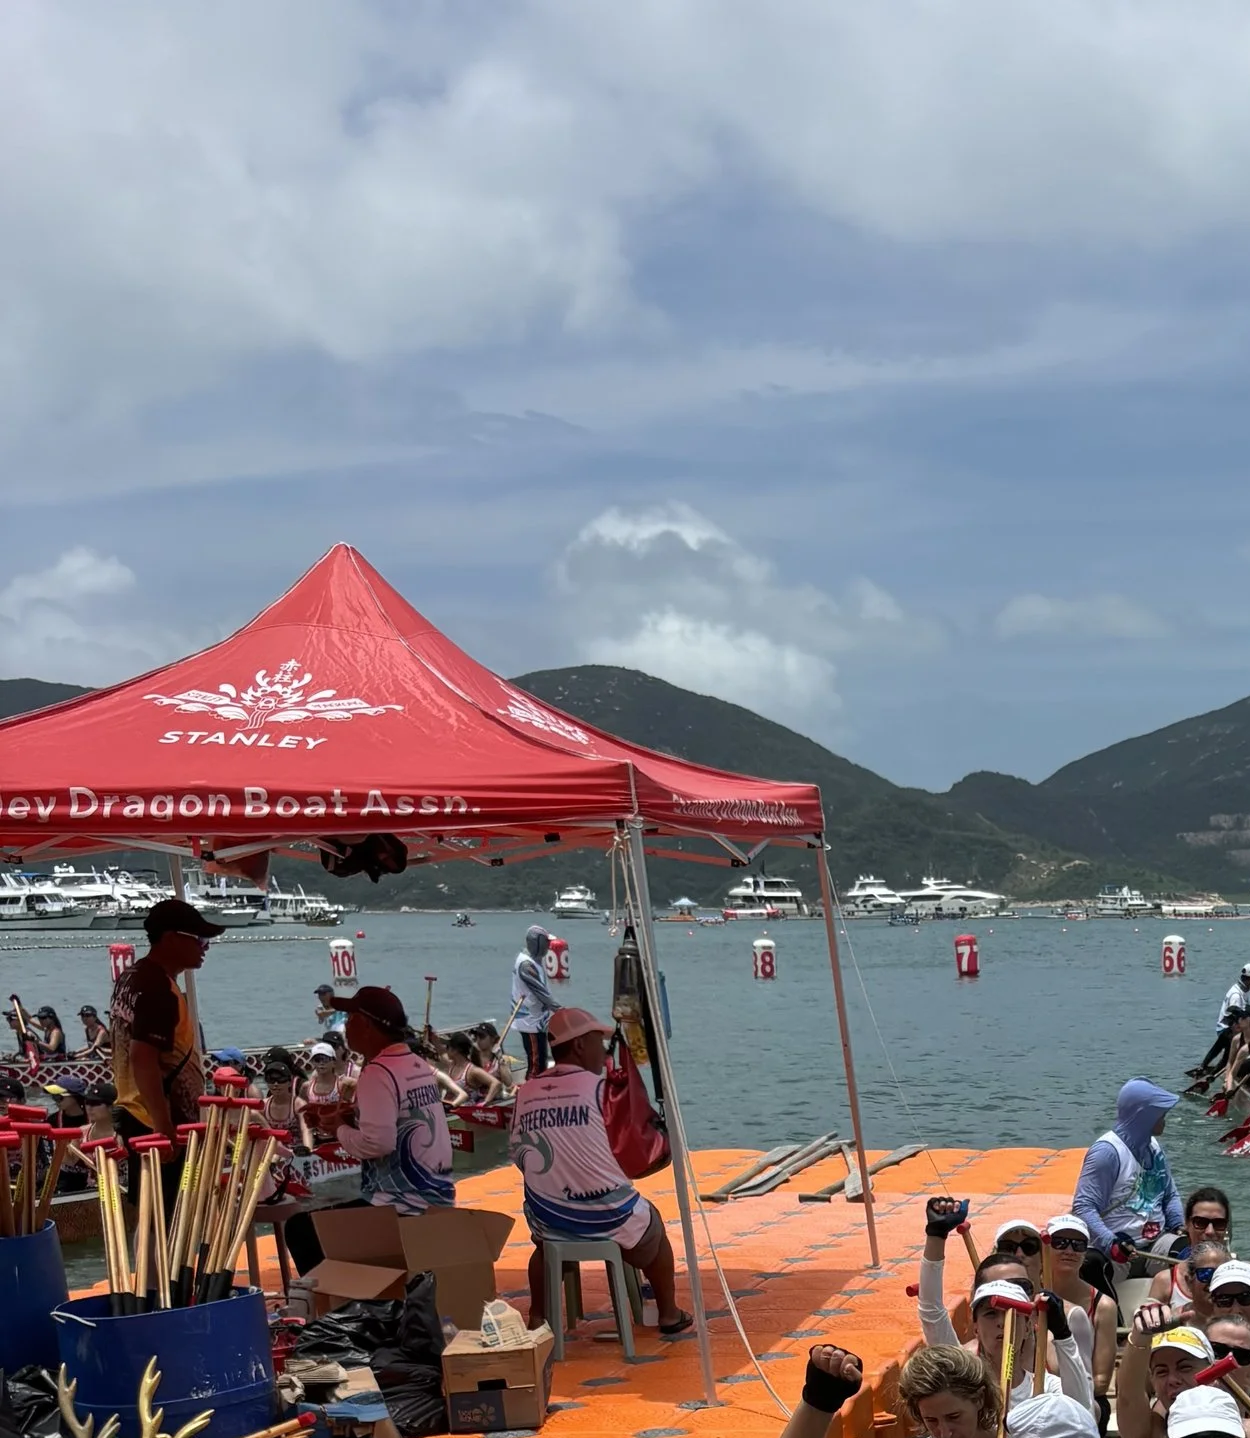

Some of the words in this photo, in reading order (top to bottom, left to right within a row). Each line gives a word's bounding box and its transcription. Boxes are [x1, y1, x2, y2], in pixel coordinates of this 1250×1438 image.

[158, 731, 328, 750] STANLEY
[0, 794, 57, 823] ey
[69, 786, 231, 820] Dragon
[243, 787, 348, 819] Boat
[359, 789, 481, 816] Assn.
[520, 1105, 590, 1134] STEERSMAN
